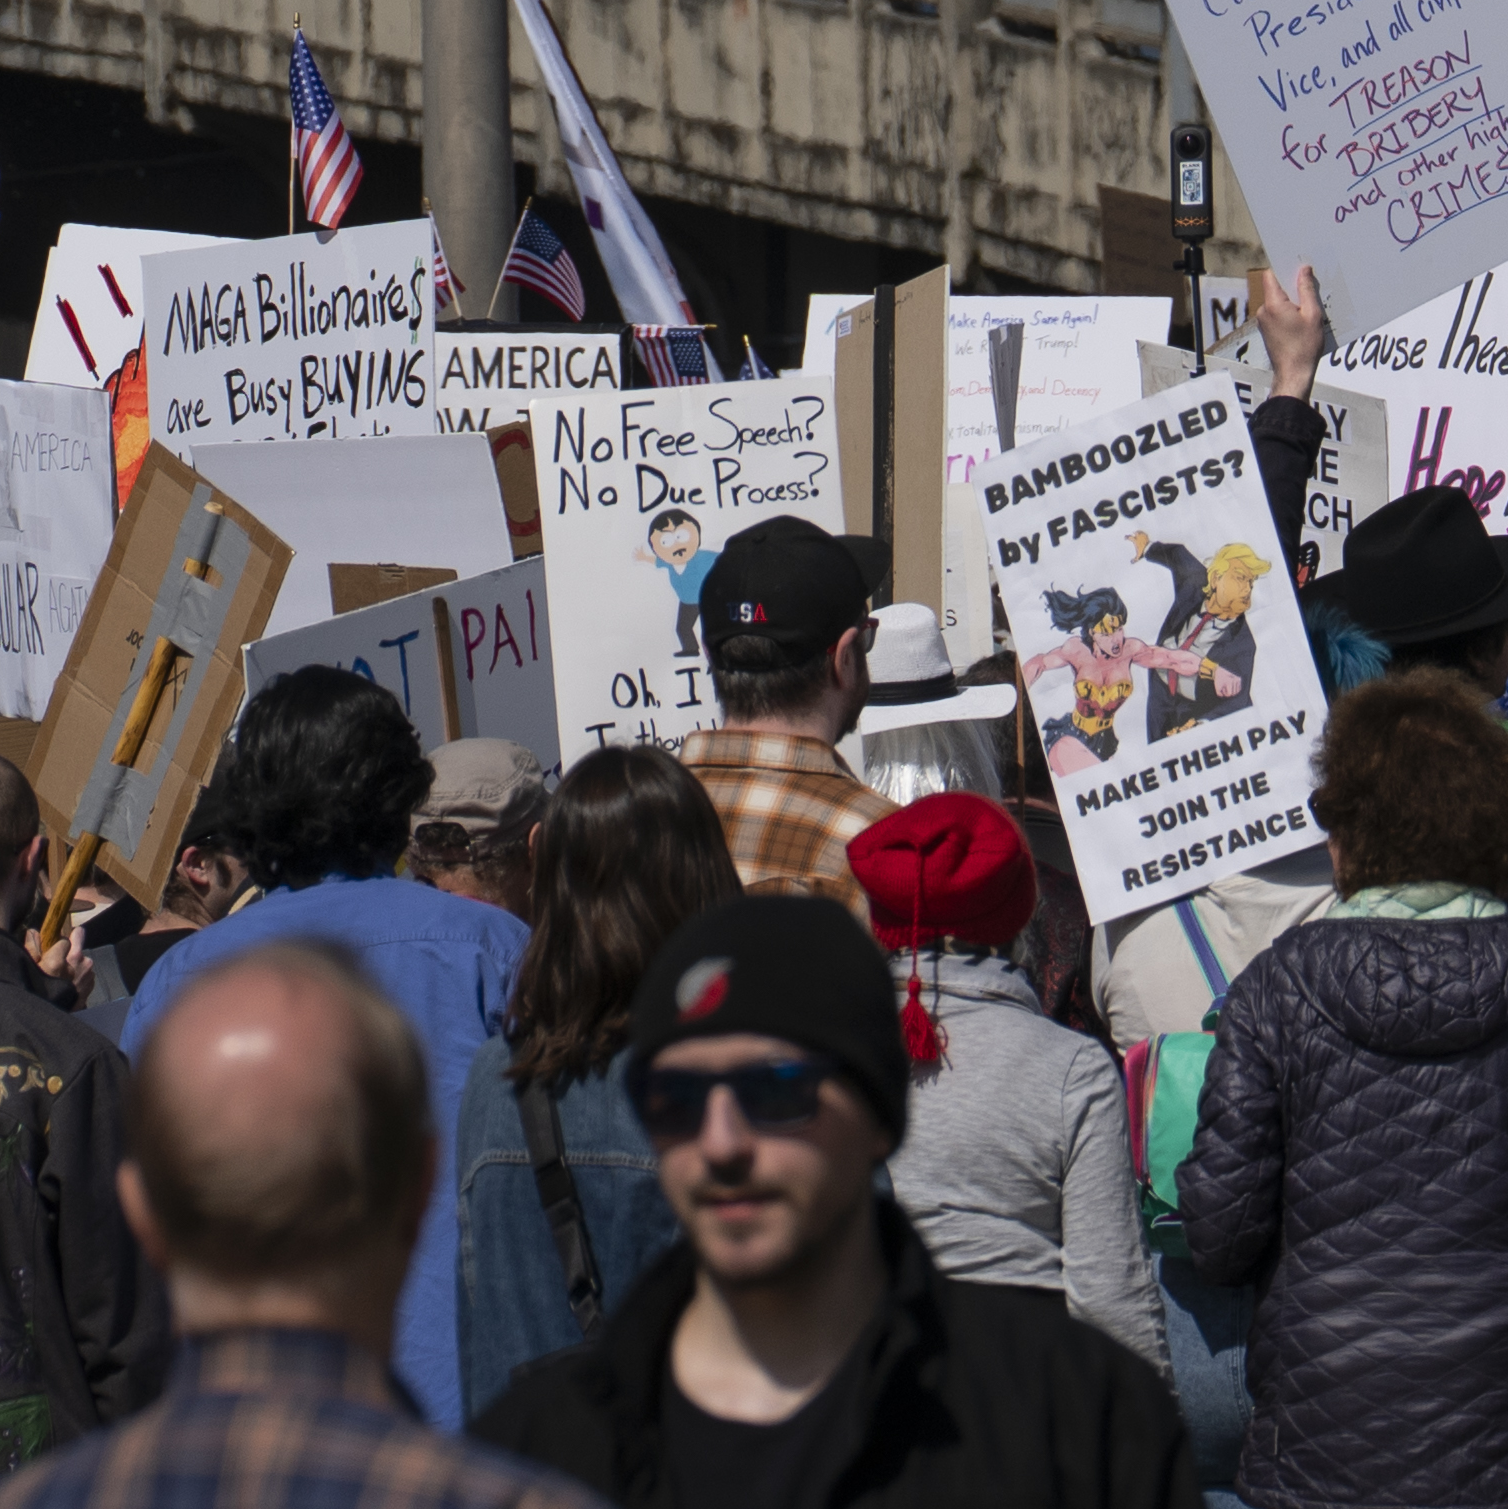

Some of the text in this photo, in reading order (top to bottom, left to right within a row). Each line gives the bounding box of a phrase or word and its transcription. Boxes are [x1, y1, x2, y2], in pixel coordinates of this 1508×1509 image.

[1340, 25, 1382, 71] and
[1389, 0, 1412, 41] all
[1281, 30, 1472, 172] for TREASON
[1336, 75, 1488, 179] BRIBERY
[1334, 176, 1387, 223] and
[1397, 140, 1459, 186] other
[163, 281, 250, 357] MAGA
[167, 393, 211, 435] are
[225, 369, 292, 432] Busy
[300, 349, 427, 420] BUYING
[442, 346, 618, 390] AMERICA
[1050, 379, 1102, 405] Decency
[11, 433, 93, 472] AMERICA
[553, 406, 615, 464] No
[620, 400, 699, 461] Free
[703, 396, 826, 452] Speech?
[984, 399, 1229, 515] BAMBOOZLED
[558, 464, 619, 514] No
[636, 464, 706, 513] Due
[712, 451, 829, 510] Process?
[997, 531, 1042, 568] by
[1047, 449, 1246, 548] FASCISTS?
[727, 601, 769, 624] USA
[612, 667, 661, 709] Oh,
[1076, 710, 1308, 817] MAKE THEM PAY
[1140, 772, 1271, 839] JOIN THE
[1121, 806, 1308, 891] RESISTANCE
